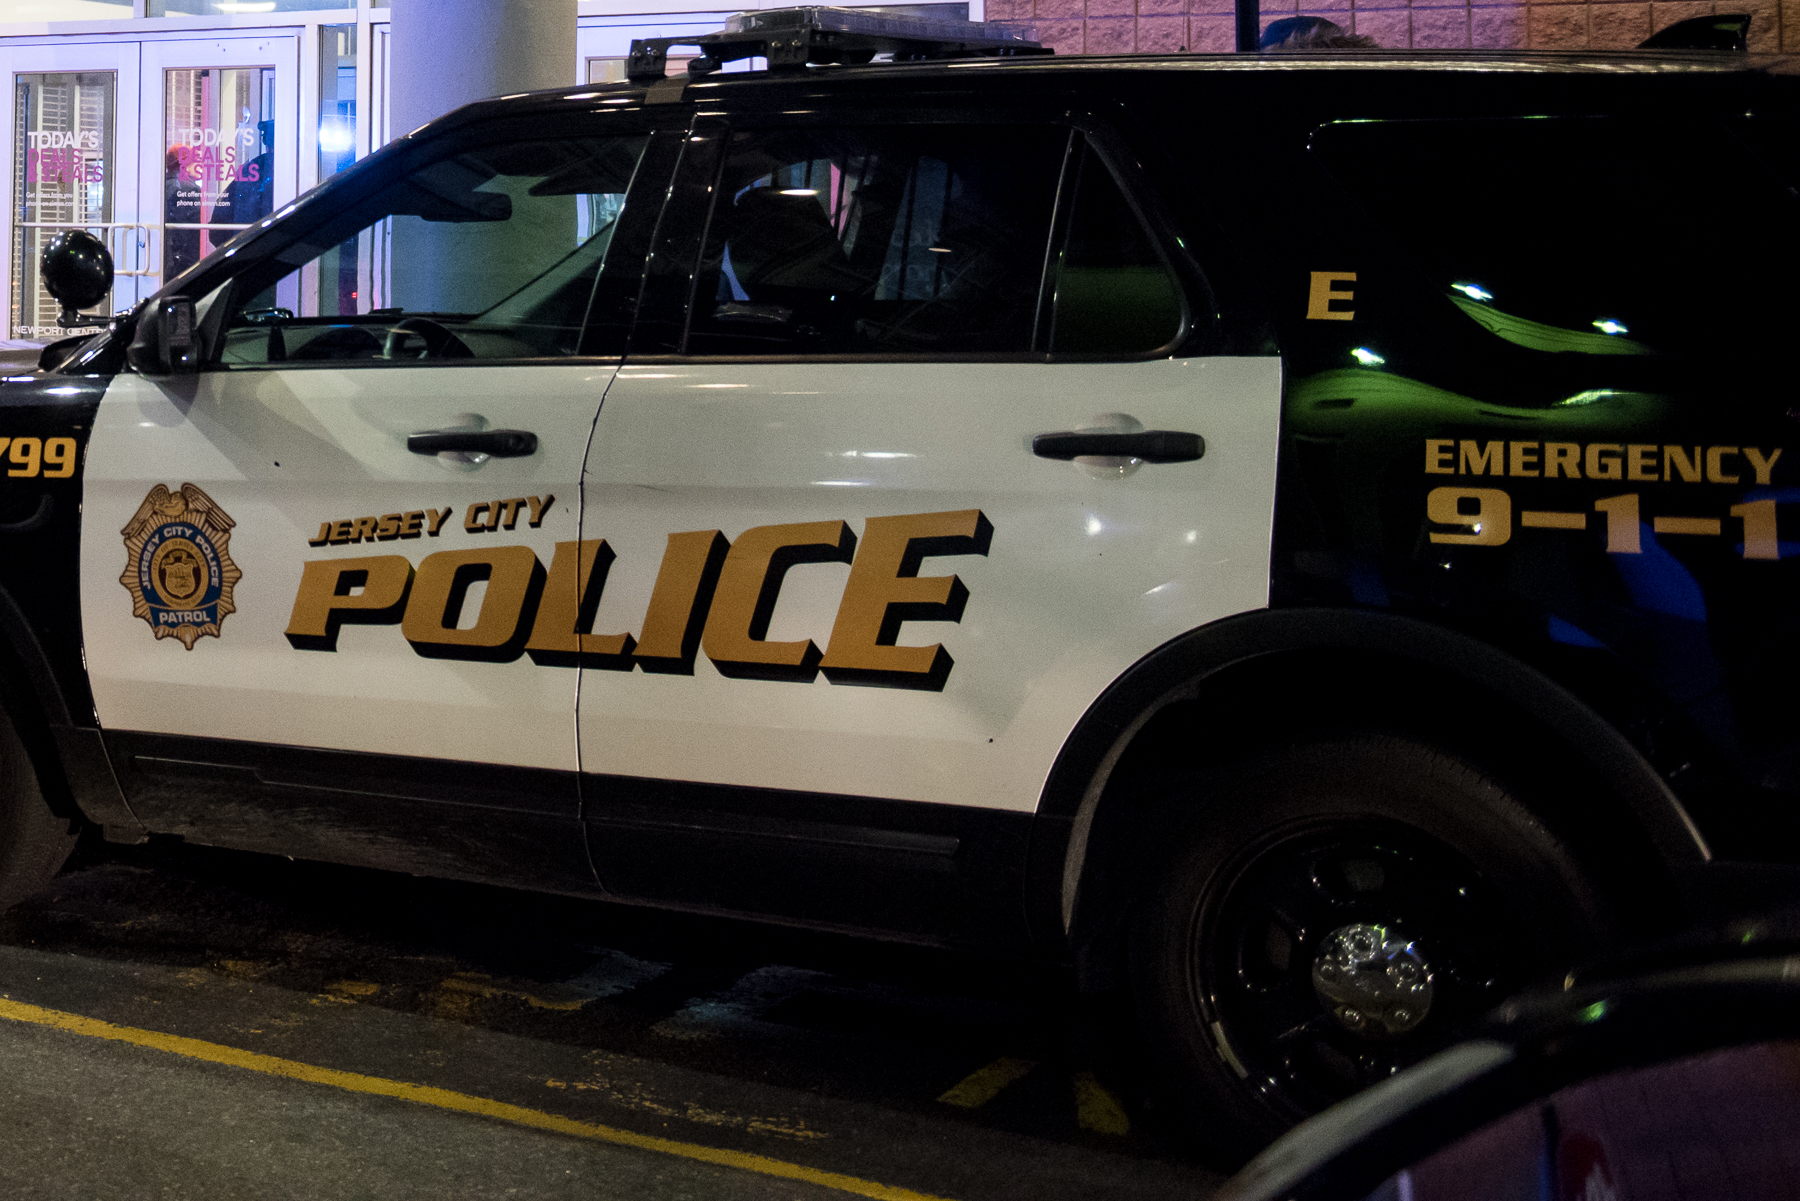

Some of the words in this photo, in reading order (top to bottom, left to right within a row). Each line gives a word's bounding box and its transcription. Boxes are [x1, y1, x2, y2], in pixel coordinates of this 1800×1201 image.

[27, 130, 99, 149] TODAY'S
[178, 127, 254, 147] TODAY'S
[27, 148, 81, 165] DEALS
[178, 146, 236, 164] DEALS
[41, 165, 103, 183] STEALS
[193, 163, 260, 182] STEALS
[176, 190, 187, 198] Get
[187, 190, 202, 198] offers
[203, 190, 217, 198] from
[217, 191, 230, 199] your
[176, 199, 194, 208] phone
[202, 199, 231, 207] simon.com
[1306, 271, 1357, 321] E
[12, 325, 64, 336] NEWPORT
[66, 327, 107, 336] CENT
[1425, 438, 1783, 485] EMERGENCY
[308, 507, 452, 547] JERSEY
[463, 494, 555, 532] CITY
[1427, 486, 1779, 559] 9-1-1
[141, 533, 160, 590] JERSEY
[163, 526, 193, 538] CITY
[195, 534, 219, 588] POLICE
[283, 509, 995, 692] POLICE
[159, 611, 211, 624] PATROL
